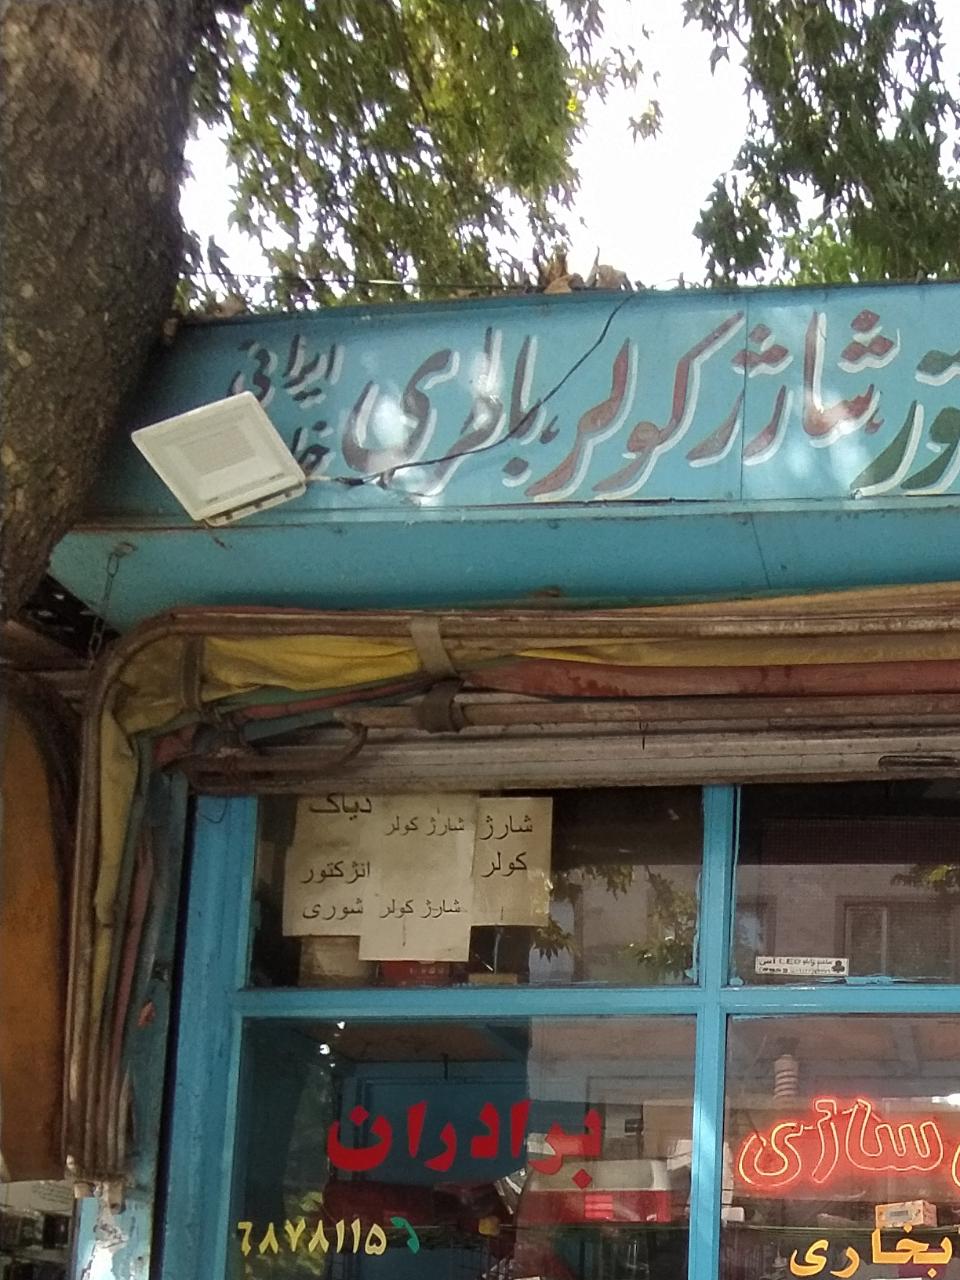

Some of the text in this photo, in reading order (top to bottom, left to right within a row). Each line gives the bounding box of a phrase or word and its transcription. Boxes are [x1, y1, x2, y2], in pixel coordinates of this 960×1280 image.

[687, 308, 898, 467] شارژ
[385, 816, 465, 837] شارژ کولر
[480, 815, 533, 840] شارژ
[481, 851, 528, 877] کولر
[380, 899, 462, 919] شارژ کولر
[328, 1100, 603, 1190] برادران
[739, 1097, 945, 1190] سازی
[789, 1223, 954, 1278] بخاری
